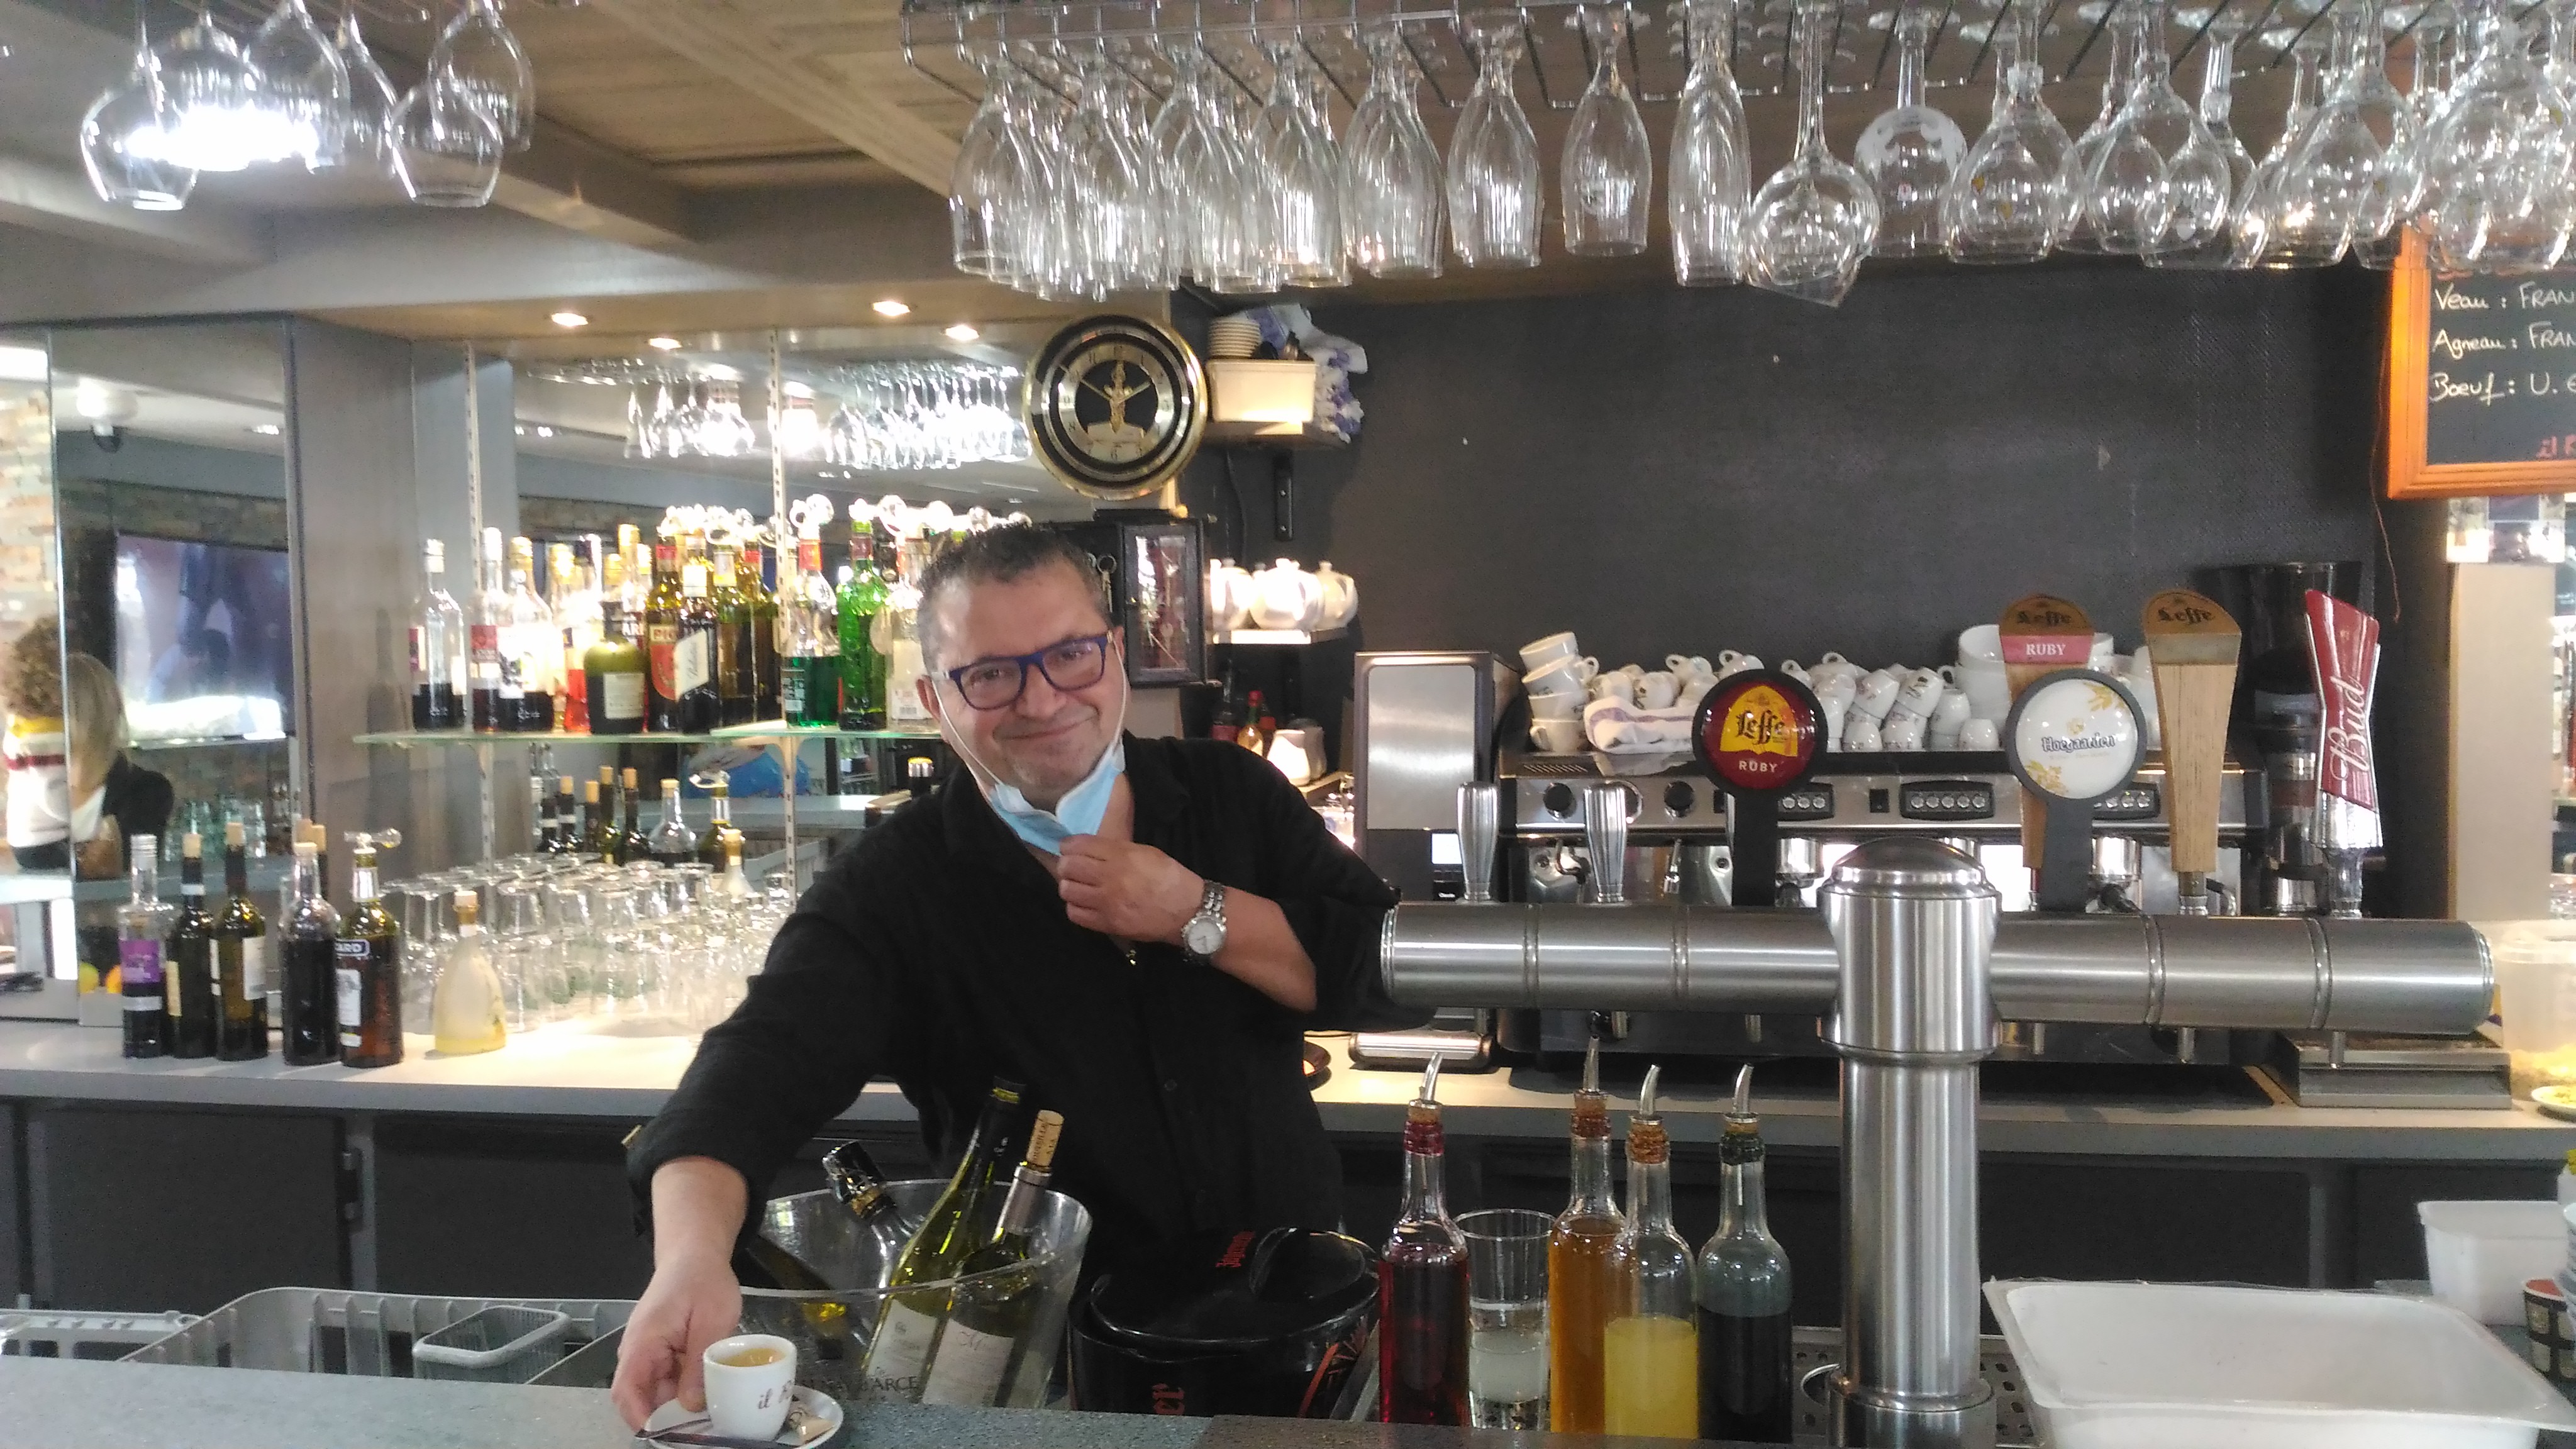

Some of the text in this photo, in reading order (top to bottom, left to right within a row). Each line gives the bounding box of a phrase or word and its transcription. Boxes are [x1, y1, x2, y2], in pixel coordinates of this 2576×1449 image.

[2434, 282, 2489, 310] Veau
[2025, 643, 2066, 656] RUBY
[1736, 709, 1785, 745] Leffe
[2326, 675, 2370, 781] Bud
[2041, 731, 2116, 753] Hoegaarden
[1738, 760, 1778, 773] RUBY
